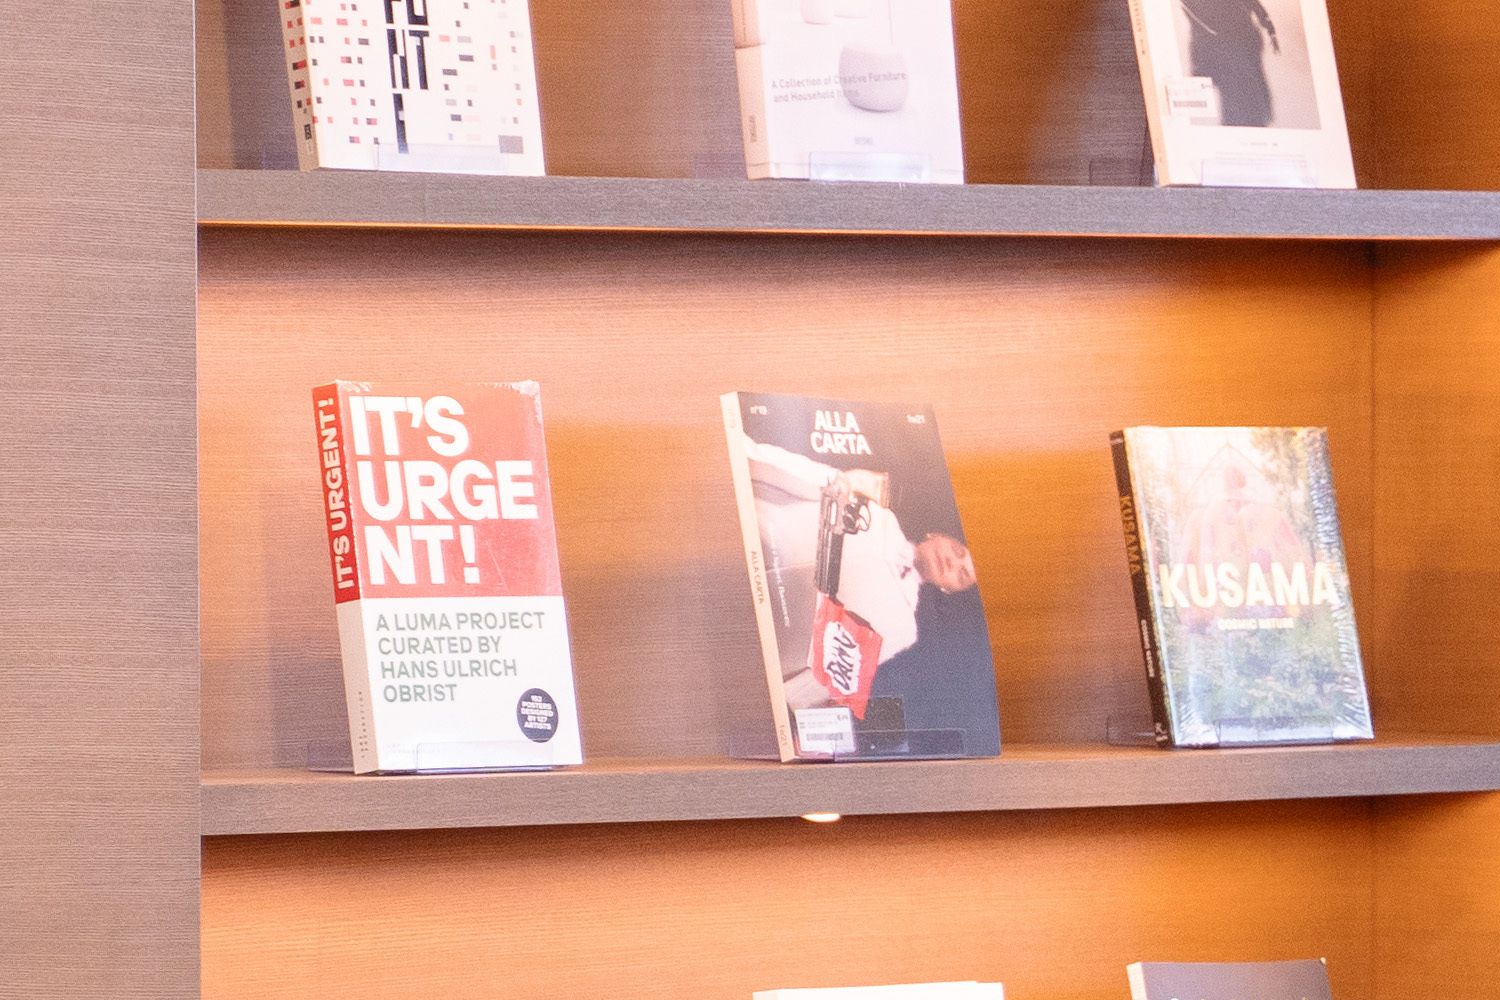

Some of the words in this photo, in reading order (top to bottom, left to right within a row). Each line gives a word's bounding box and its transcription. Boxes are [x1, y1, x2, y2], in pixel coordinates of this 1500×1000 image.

[778, 78, 821, 88] Collection
[868, 72, 907, 82] Furniture
[773, 92, 789, 102] and
[814, 409, 860, 433] ALLA
[810, 431, 872, 455] CARTA
[318, 397, 348, 531] URGENT!
[357, 459, 538, 521] URGE
[1120, 496, 1142, 576] KUSAMA
[333, 534, 356, 590] IT'S
[364, 525, 480, 585] NT!
[1159, 561, 1340, 608] KUSAMA
[376, 614, 390, 631] A
[394, 613, 451, 631] LUMA
[456, 611, 545, 630] PROJECT
[378, 636, 473, 655] CURATED
[478, 635, 502, 653] BY
[380, 660, 438, 679] HANS
[443, 659, 518, 677] ULRICH
[383, 684, 457, 703] OBRIST
